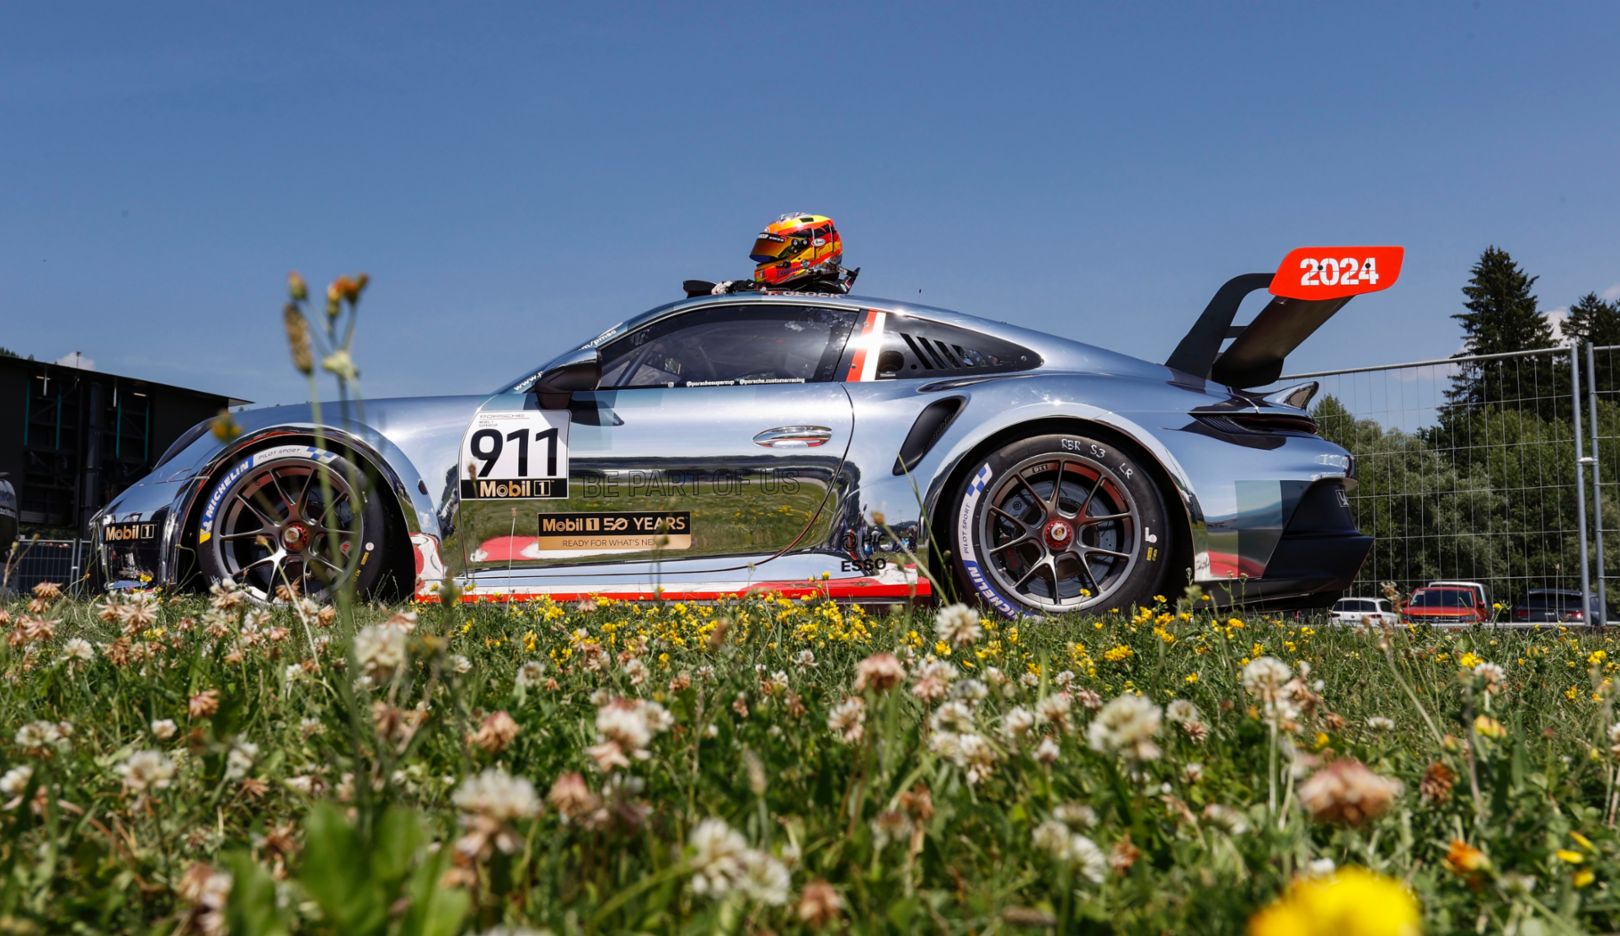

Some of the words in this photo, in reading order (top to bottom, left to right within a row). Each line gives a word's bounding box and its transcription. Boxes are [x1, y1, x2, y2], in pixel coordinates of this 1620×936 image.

[1300, 257, 1379, 286] 2024
[470, 427, 559, 478] 911
[1061, 438, 1080, 450] RBR
[1090, 444, 1106, 458] S3
[1119, 462, 1133, 479] LR
[205, 460, 250, 518] MICHELIN
[480, 480, 531, 497] Mobil
[582, 470, 619, 498] BE
[628, 470, 700, 498] PART
[712, 469, 751, 497] OF
[760, 468, 801, 496] US
[105, 525, 140, 541] Mobil
[543, 518, 583, 532] Mobil
[604, 517, 629, 531] 50
[633, 516, 686, 531] YEARS
[562, 540, 588, 548] READY
[590, 539, 608, 547] FOR
[609, 538, 640, 547] WHAT'S
[841, 558, 887, 573] ESSO
